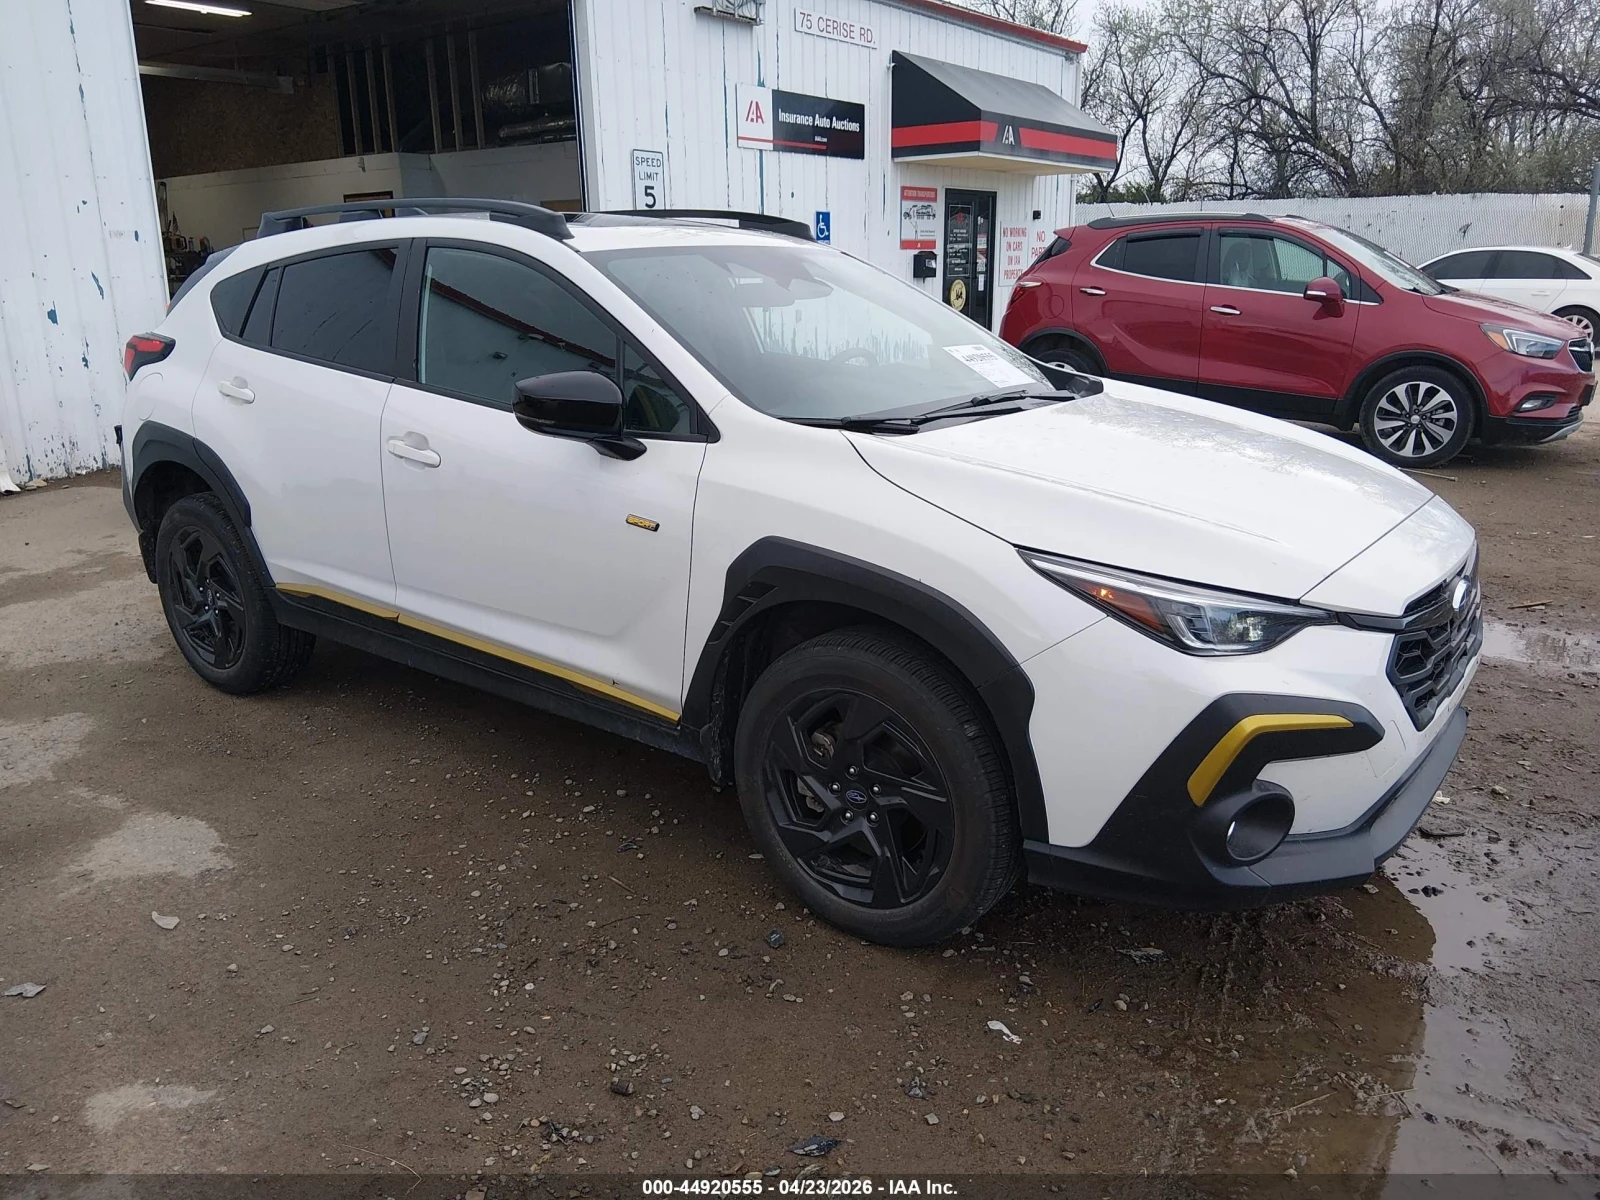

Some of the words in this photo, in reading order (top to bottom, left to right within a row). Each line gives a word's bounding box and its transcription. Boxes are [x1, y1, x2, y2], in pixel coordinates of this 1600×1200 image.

[799, 11, 813, 30] 75
[817, 16, 855, 40] CERISE
[859, 26, 876, 45] RD.
[778, 108, 813, 126] Insurance
[814, 113, 831, 129] Auto
[831, 116, 860, 132] Auctions
[635, 156, 662, 168] SPEED
[638, 170, 659, 182] LIMIT
[644, 185, 657, 209] 5
[1002, 227, 1009, 238] NO
[1010, 227, 1027, 238] WORKING
[1036, 230, 1046, 242] NO
[1006, 241, 1012, 252] ON
[1013, 241, 1023, 252] CARS
[1008, 255, 1013, 266] ON
